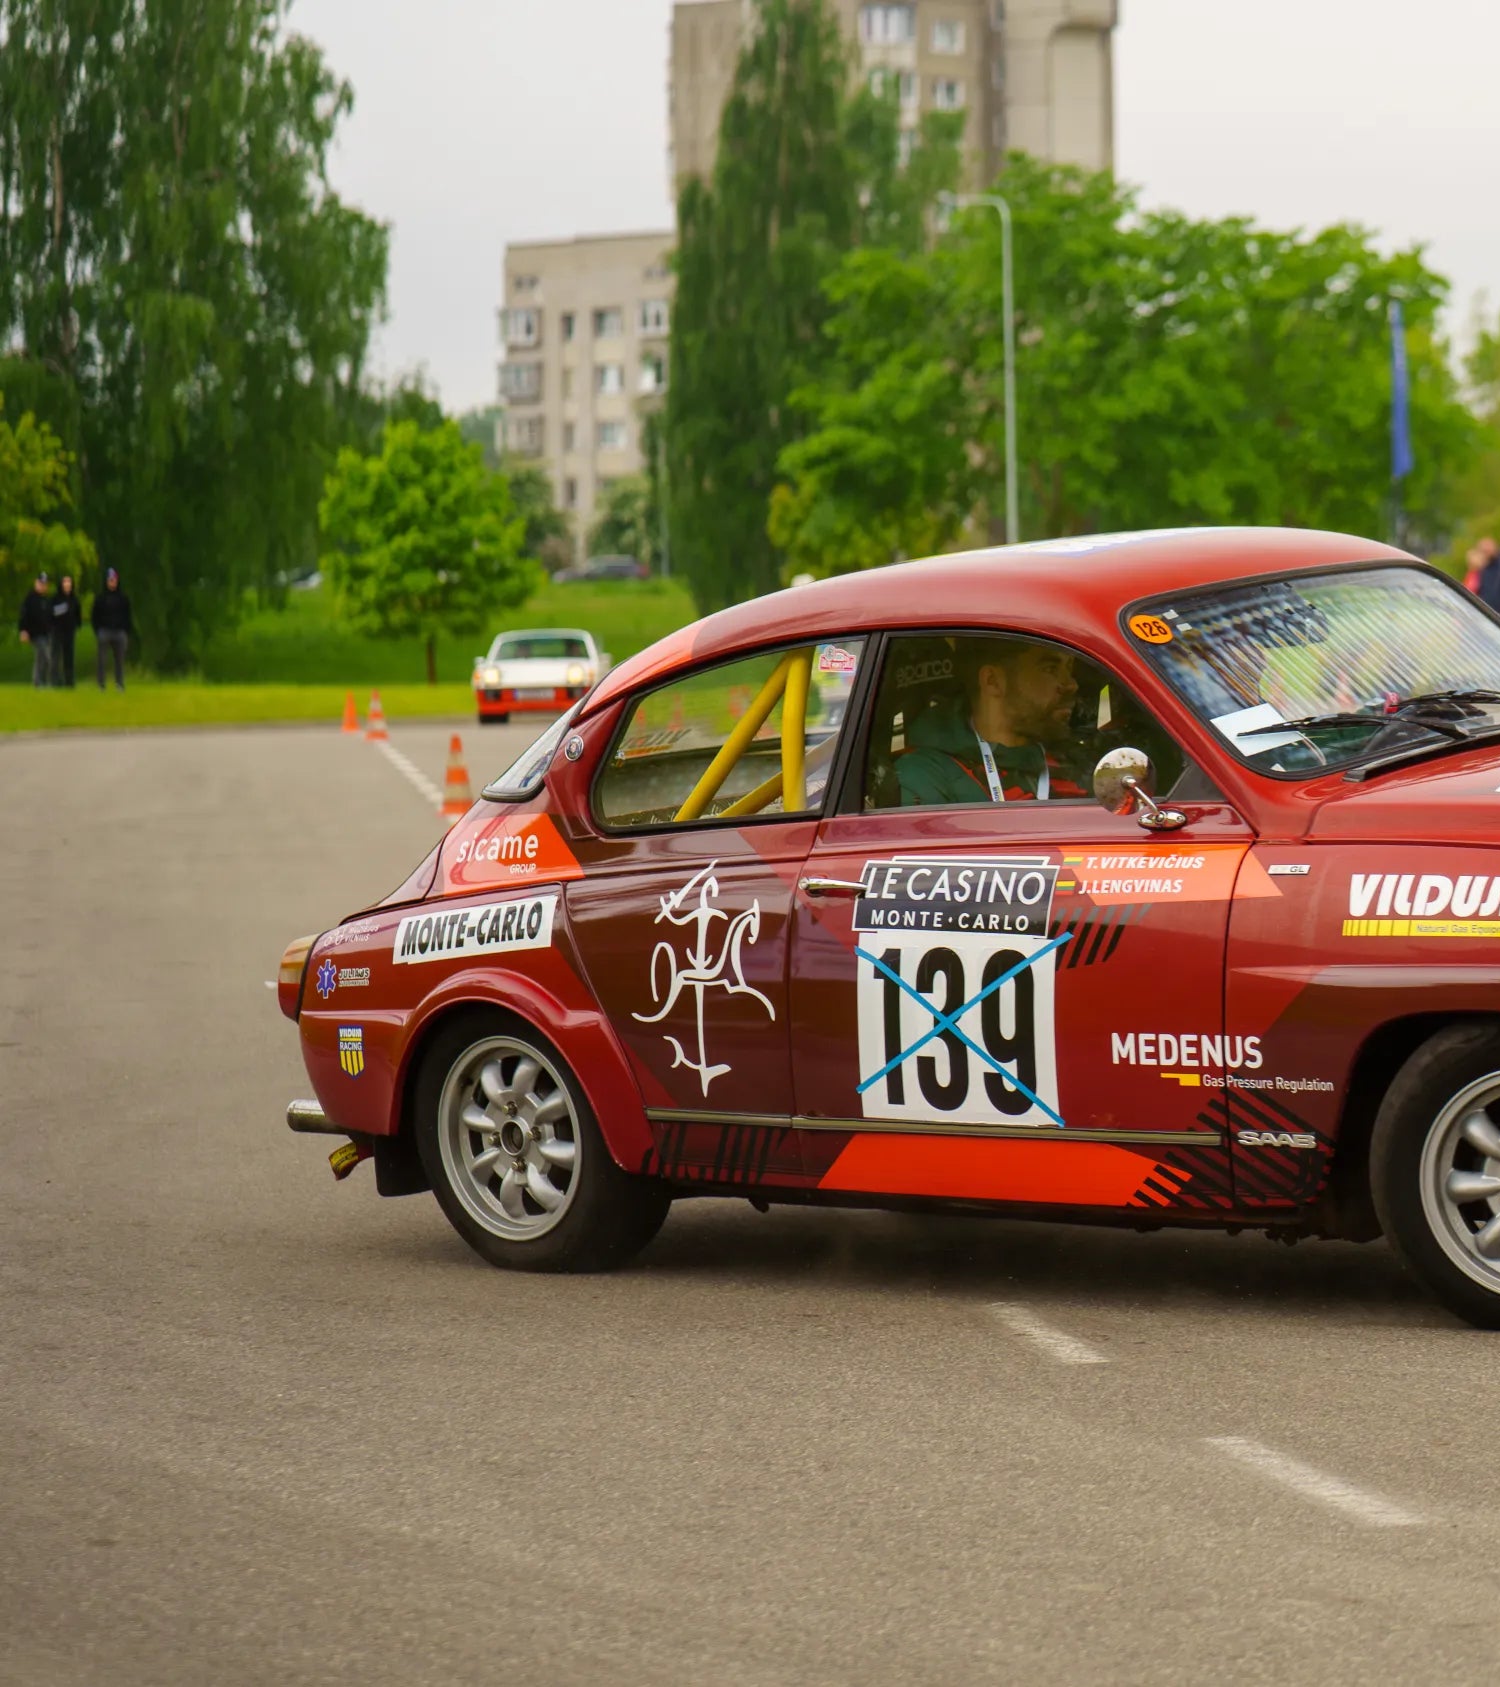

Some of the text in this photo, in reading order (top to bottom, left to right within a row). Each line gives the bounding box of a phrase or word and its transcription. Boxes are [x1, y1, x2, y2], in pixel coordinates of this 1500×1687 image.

[1136, 621, 1168, 638] 126
[456, 833, 539, 863] sicame
[509, 863, 537, 875] GROUP
[1086, 854, 1205, 869] T.VITKEVIČIUS
[865, 867, 1046, 906] LE CASINO
[1078, 879, 1184, 895] J.LENGVINAS
[400, 901, 543, 957] MONTE-CARLO
[870, 908, 1030, 932] MONTE CARLO
[1416, 924, 1449, 933] Natural
[1452, 924, 1468, 934] Gas
[873, 946, 1038, 1116] 139
[339, 1041, 363, 1051] RACING
[1111, 1032, 1264, 1069] MEDENUS
[1202, 1075, 1335, 1093] Gas Pressure Regulation
[1237, 1131, 1317, 1149] SAAB
